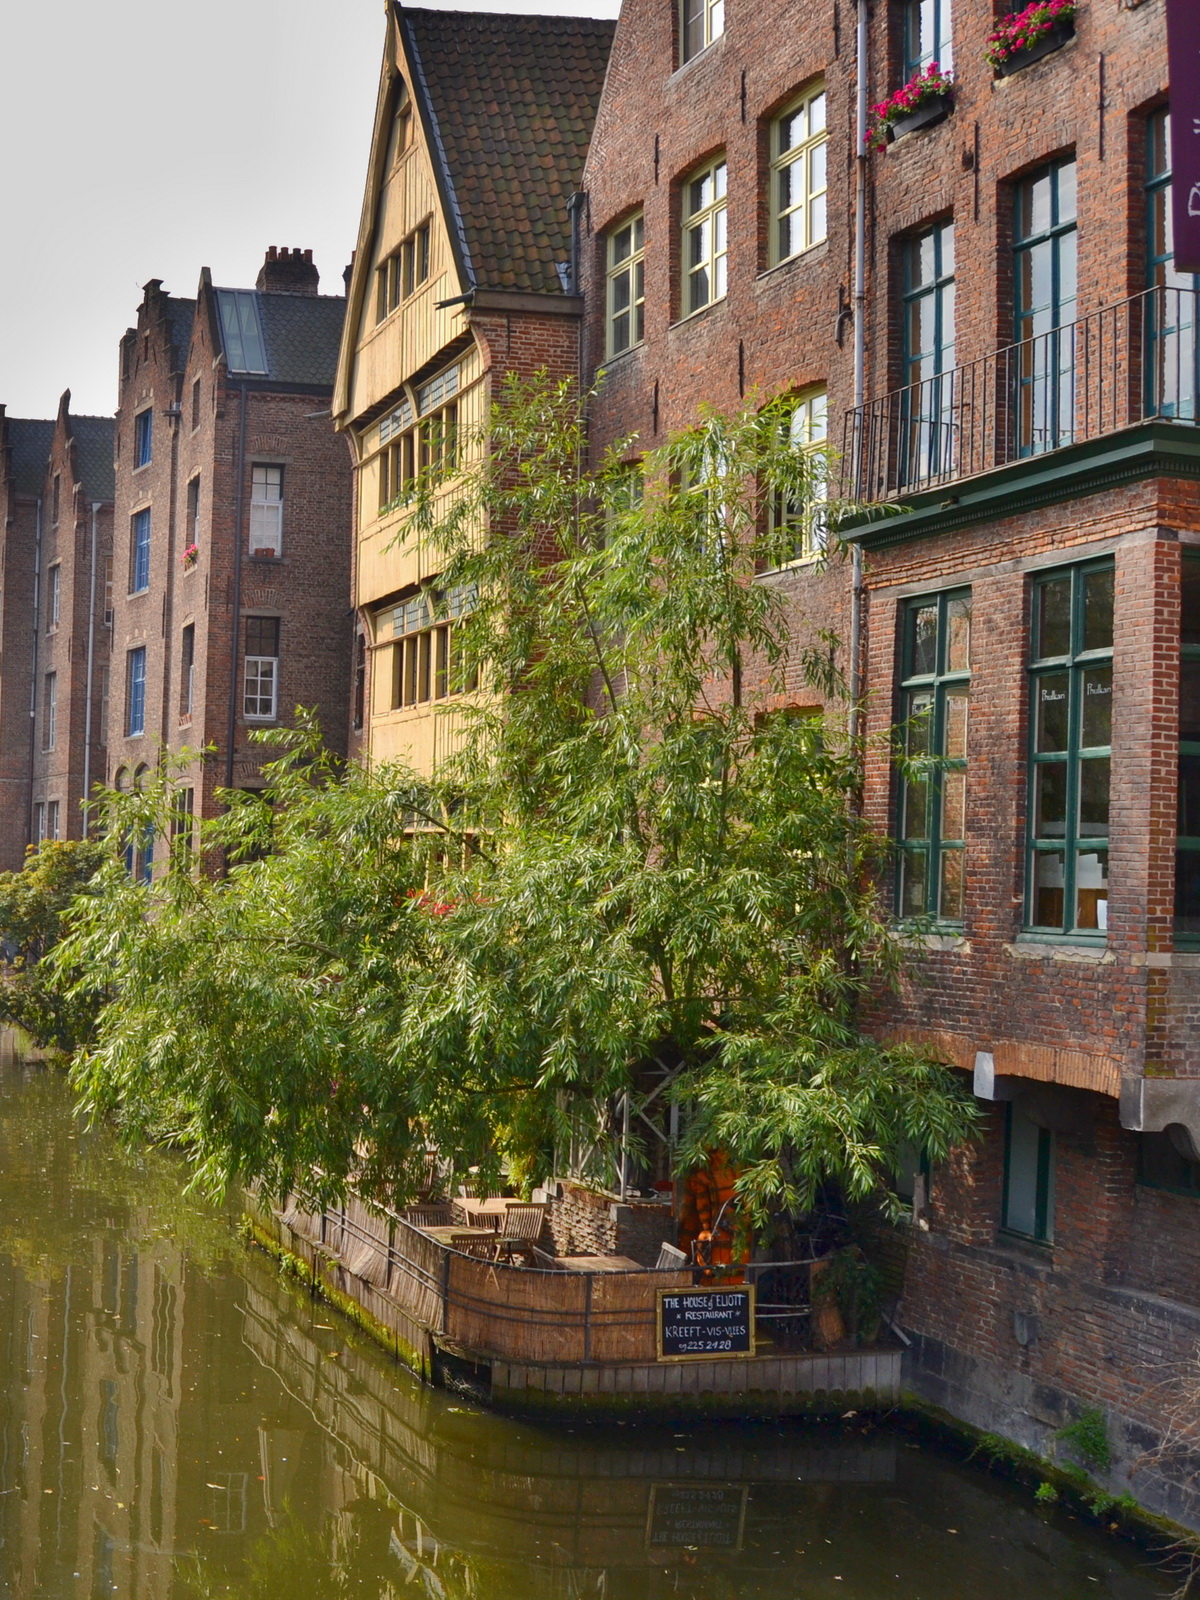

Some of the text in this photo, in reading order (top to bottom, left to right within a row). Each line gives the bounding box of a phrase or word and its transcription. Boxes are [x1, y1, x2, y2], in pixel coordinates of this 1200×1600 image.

[664, 1298, 680, 1309] THE
[683, 1296, 708, 1308] HOUSE
[716, 1294, 746, 1307] ELIOTT
[685, 1310, 734, 1320] RESTAURANT
